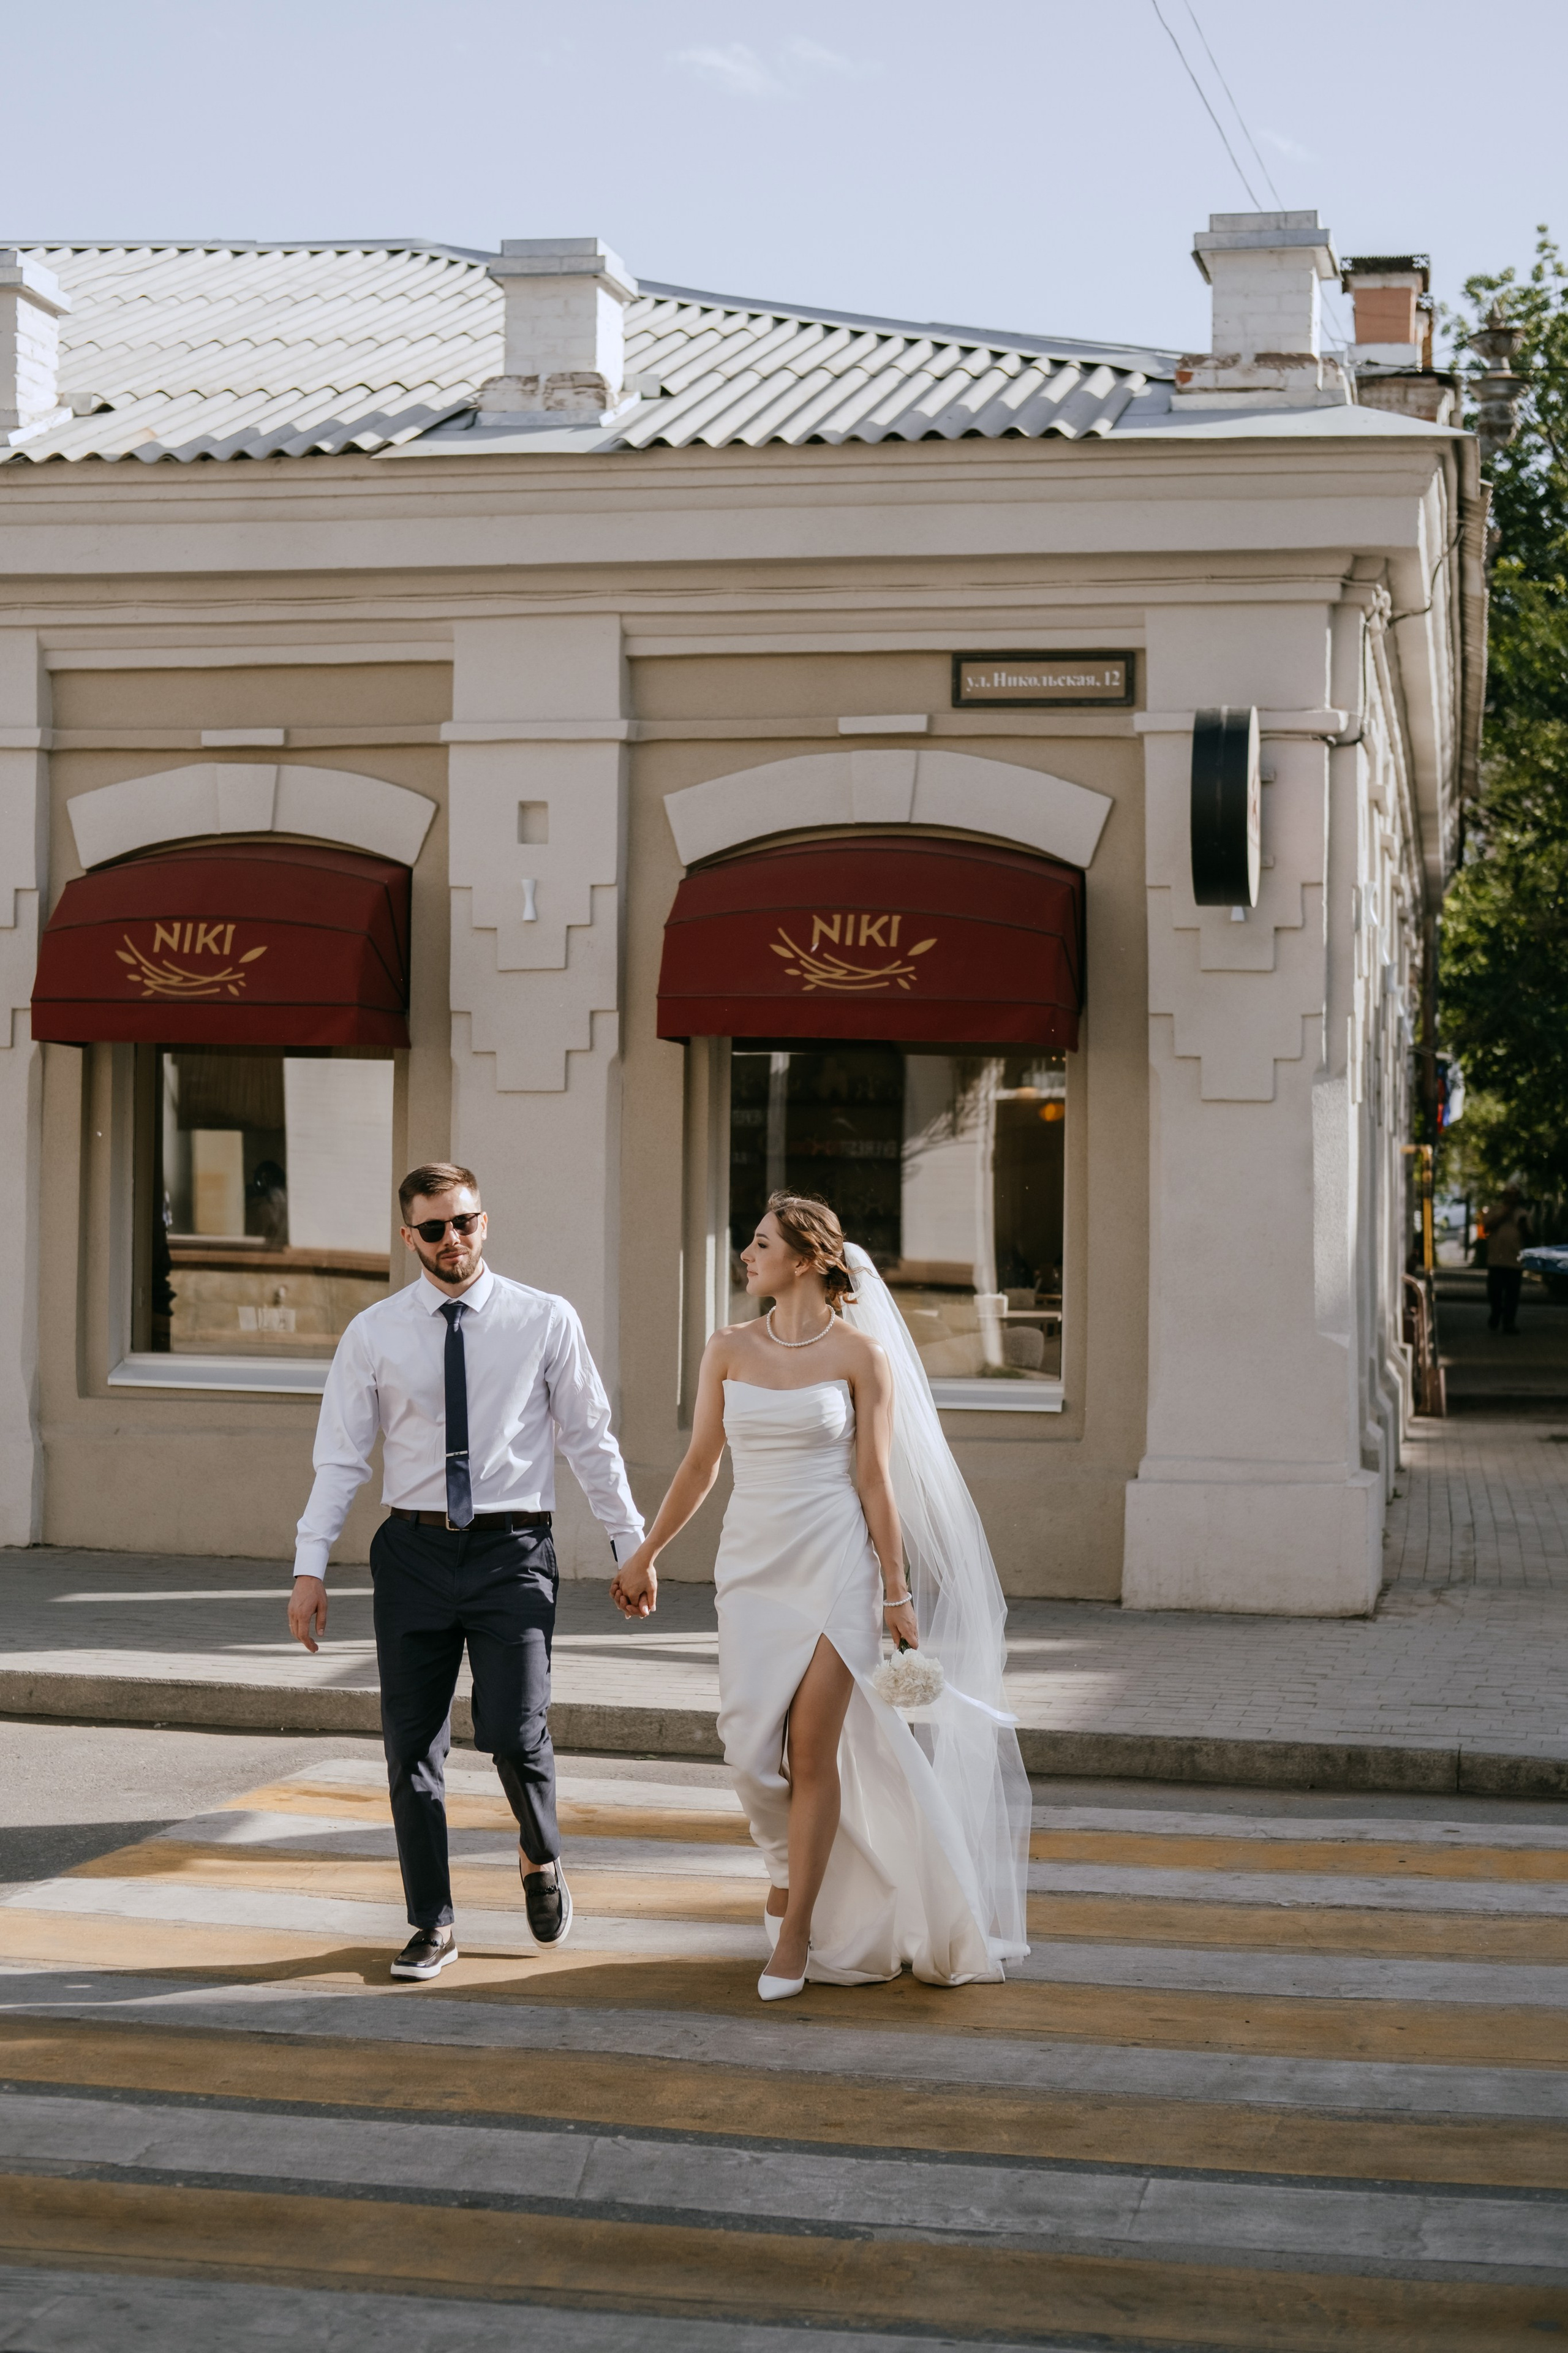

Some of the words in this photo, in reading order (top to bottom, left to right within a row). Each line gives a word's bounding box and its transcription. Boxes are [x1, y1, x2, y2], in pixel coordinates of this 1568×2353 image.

[967, 676, 990, 692] ул.
[1105, 671, 1120, 686] 12
[153, 923, 236, 955] NIKI
[812, 914, 902, 947] NIKI
